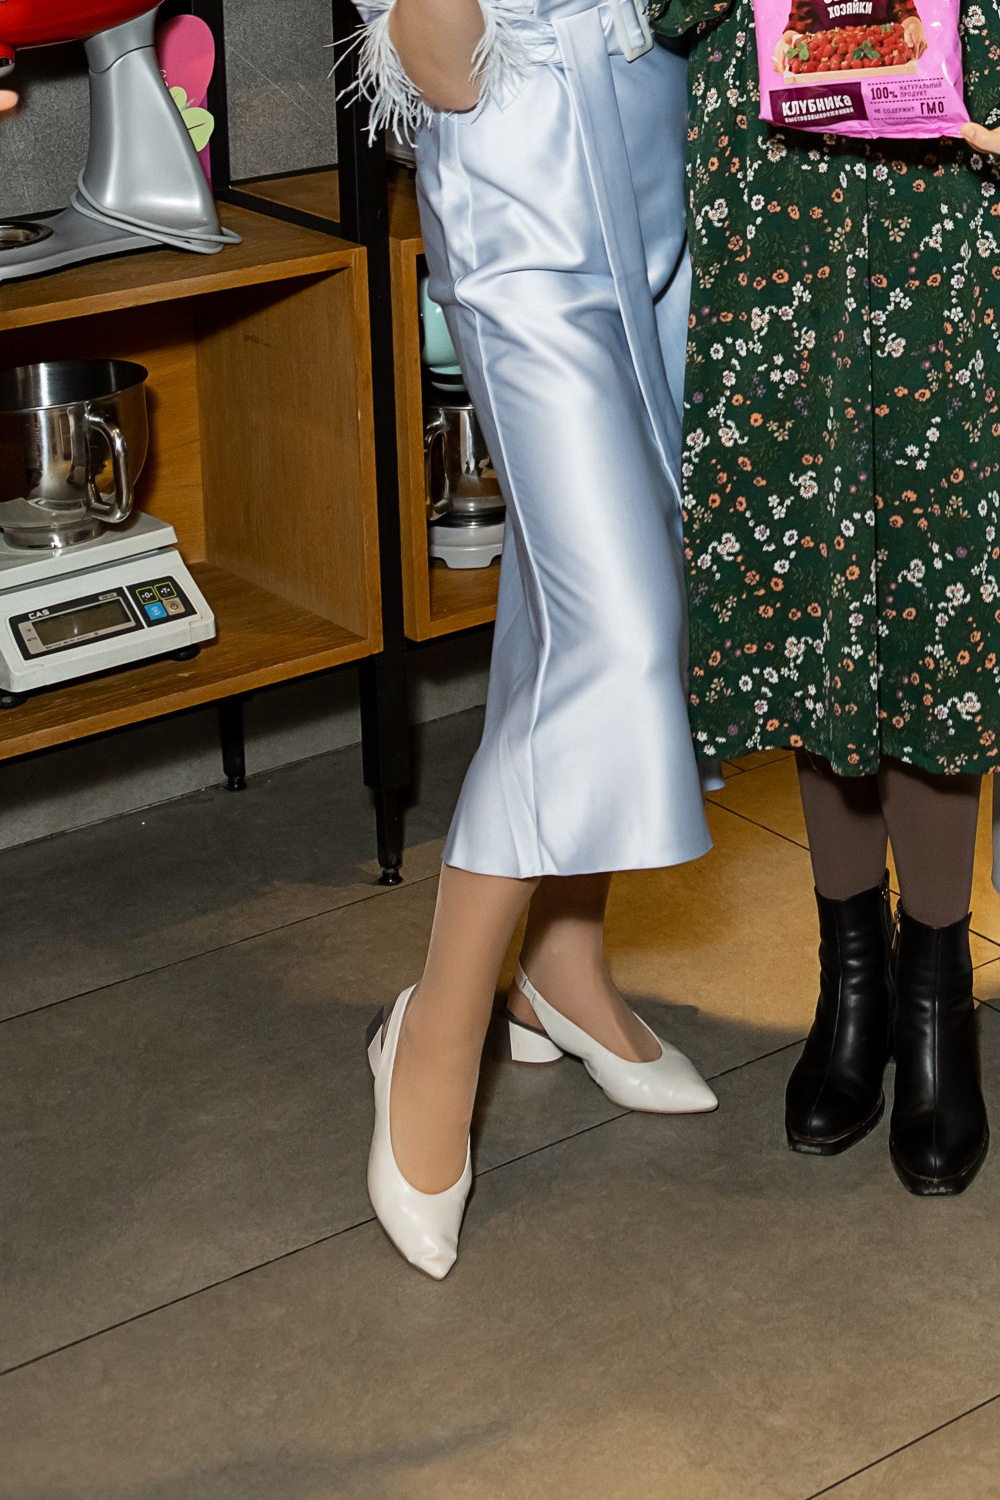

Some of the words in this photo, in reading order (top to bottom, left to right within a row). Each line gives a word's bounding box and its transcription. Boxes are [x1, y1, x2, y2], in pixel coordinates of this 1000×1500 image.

[870, 86, 898, 101] 100%
[900, 90, 927, 99] ПРОДУКТ
[920, 100, 945, 115] ГМО
[28, 608, 50, 620] CAS
